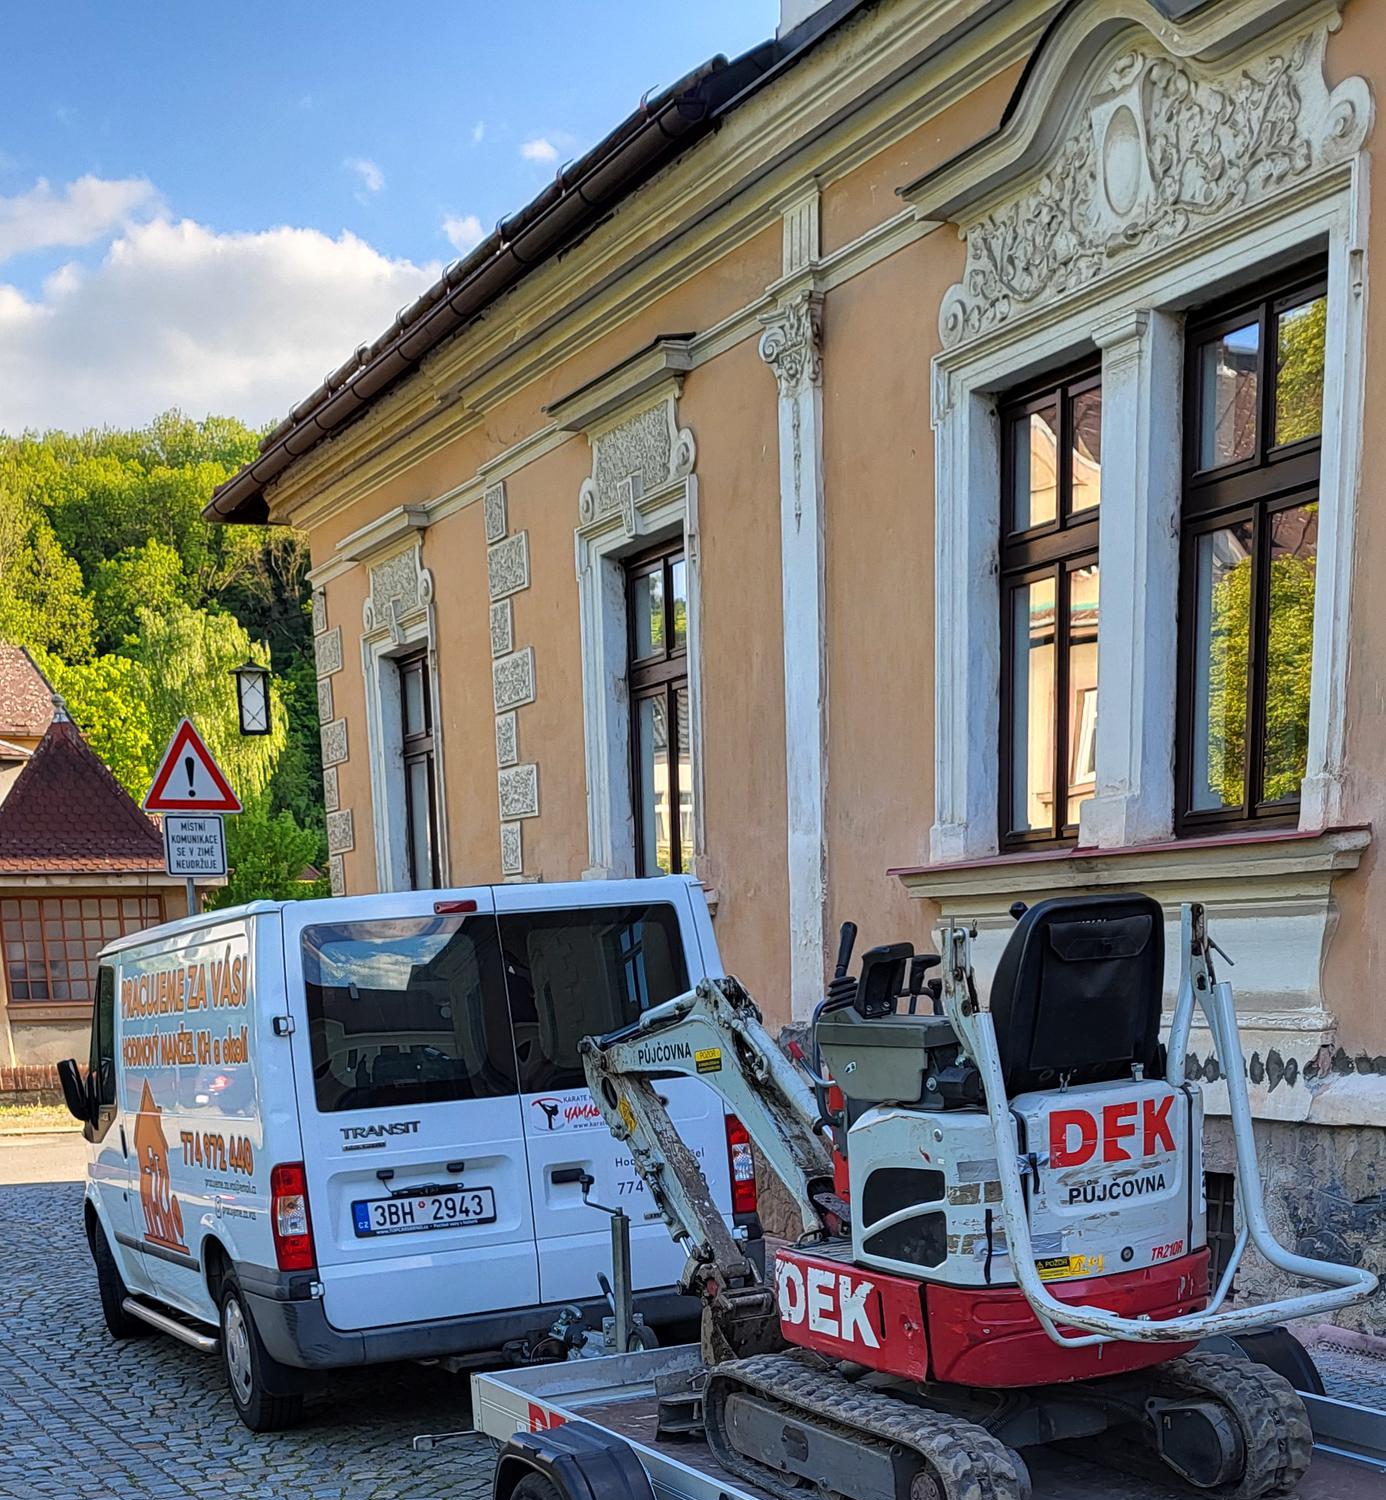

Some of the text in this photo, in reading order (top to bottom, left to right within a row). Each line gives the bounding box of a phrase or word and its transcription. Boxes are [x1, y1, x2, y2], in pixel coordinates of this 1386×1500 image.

[181, 820, 206, 831] MÍSTNÍ
[171, 834, 218, 844] KOMUNIKACE
[177, 845, 215, 856] SE V ZIMĚ
[176, 858, 217, 869] NEUDRŽUJE
[122, 943, 248, 1019] PRACUJEME ZA VÁS!
[161, 1021, 196, 1067] MANŽEL
[197, 1030, 212, 1066] KH
[638, 1042, 692, 1065] PŮJČOVNA
[563, 1094, 587, 1103] KARATE
[340, 1120, 420, 1139] TRANSIT
[1049, 1095, 1176, 1169] DEK
[180, 1131, 254, 1177] 774 972 440
[617, 1180, 644, 1195] 774
[1069, 1173, 1166, 1205] PŮJČOVNA
[374, 1194, 484, 1227] 3BH 2943
[1045, 1257, 1068, 1267] POZOR
[775, 1258, 880, 1348] DEK
